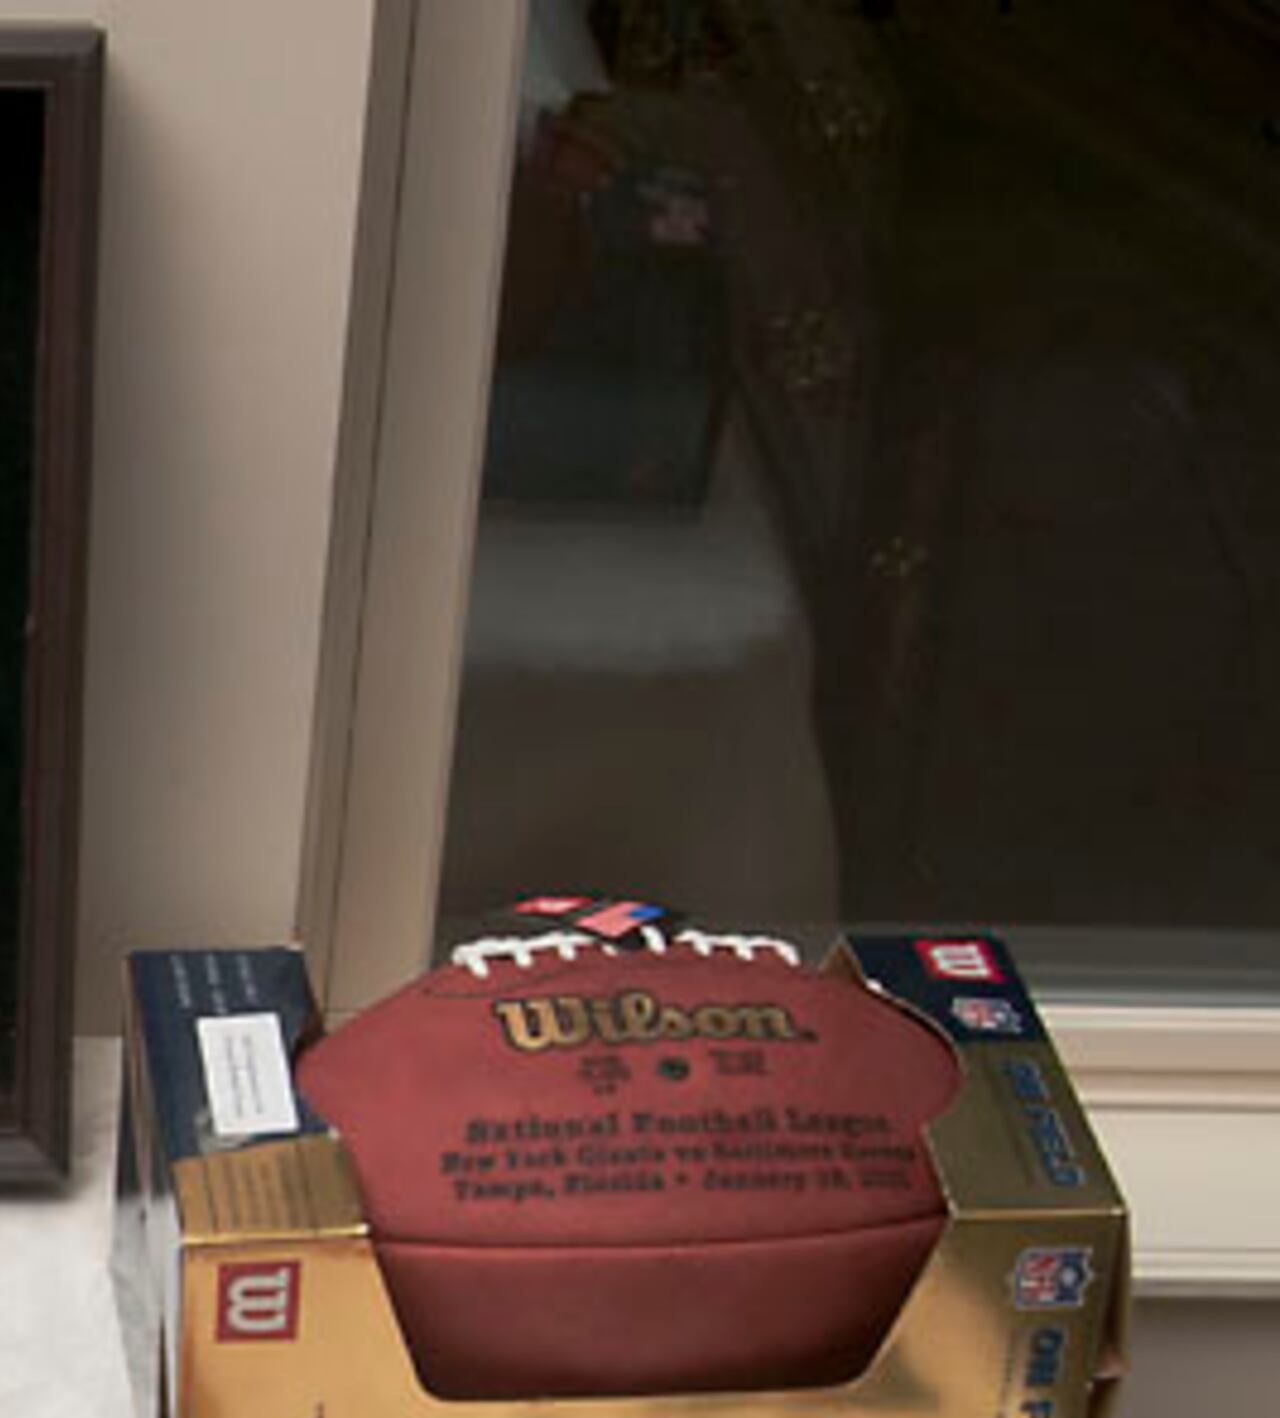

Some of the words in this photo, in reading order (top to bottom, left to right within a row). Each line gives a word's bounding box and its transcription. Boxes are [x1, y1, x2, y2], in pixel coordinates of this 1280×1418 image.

[493, 990, 795, 1051] Wilson
[465, 1113, 619, 1145] National
[632, 1106, 778, 1136] Football
